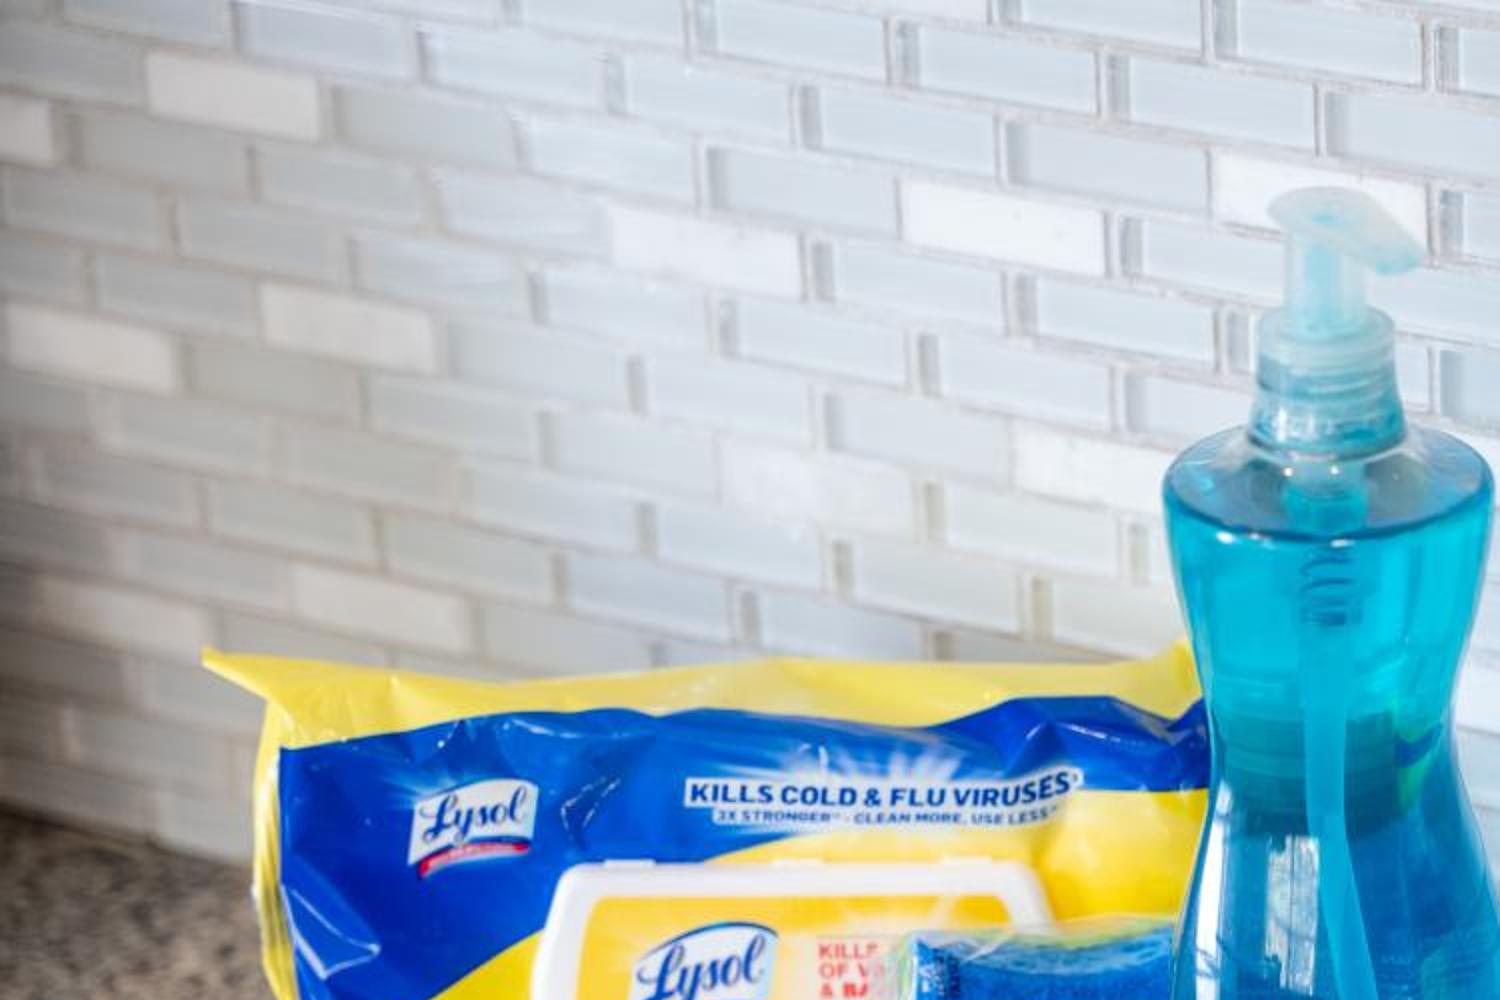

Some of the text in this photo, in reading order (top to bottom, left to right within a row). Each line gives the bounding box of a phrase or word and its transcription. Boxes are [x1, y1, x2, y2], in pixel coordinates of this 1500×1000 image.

[691, 783, 773, 806] KILLS
[780, 786, 857, 806] COLD
[865, 788, 881, 807] &
[890, 788, 945, 807] FLU
[419, 785, 527, 844] Lysol
[854, 812, 910, 825] CLEAN
[971, 812, 1001, 825] USE
[819, 962, 847, 977] OF
